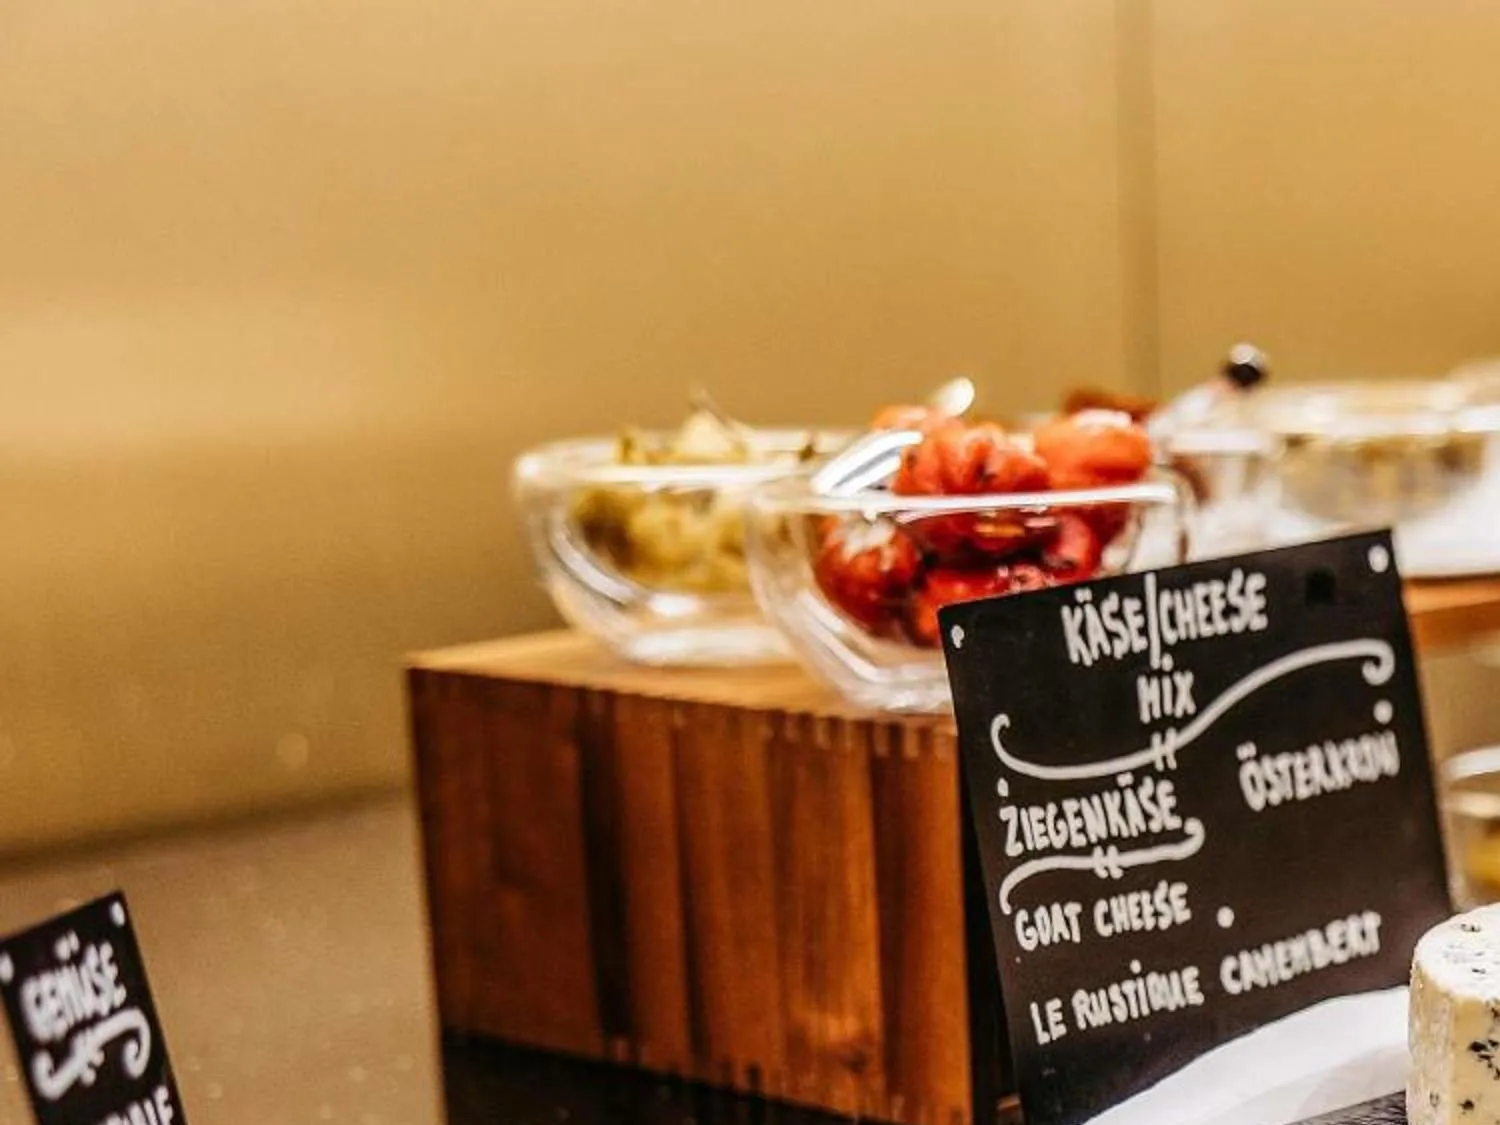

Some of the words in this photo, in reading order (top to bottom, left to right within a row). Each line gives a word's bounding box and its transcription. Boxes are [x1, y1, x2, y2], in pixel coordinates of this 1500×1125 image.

[1000, 771, 1182, 857] ZIEGENKÄSE
[1015, 901, 1083, 950] GOAT
[1094, 881, 1191, 937] CHEESE
[1030, 998, 1067, 1045] LE
[1072, 959, 1205, 1030] RUSTIQUE
[1220, 910, 1381, 994] CAMEMBERT
